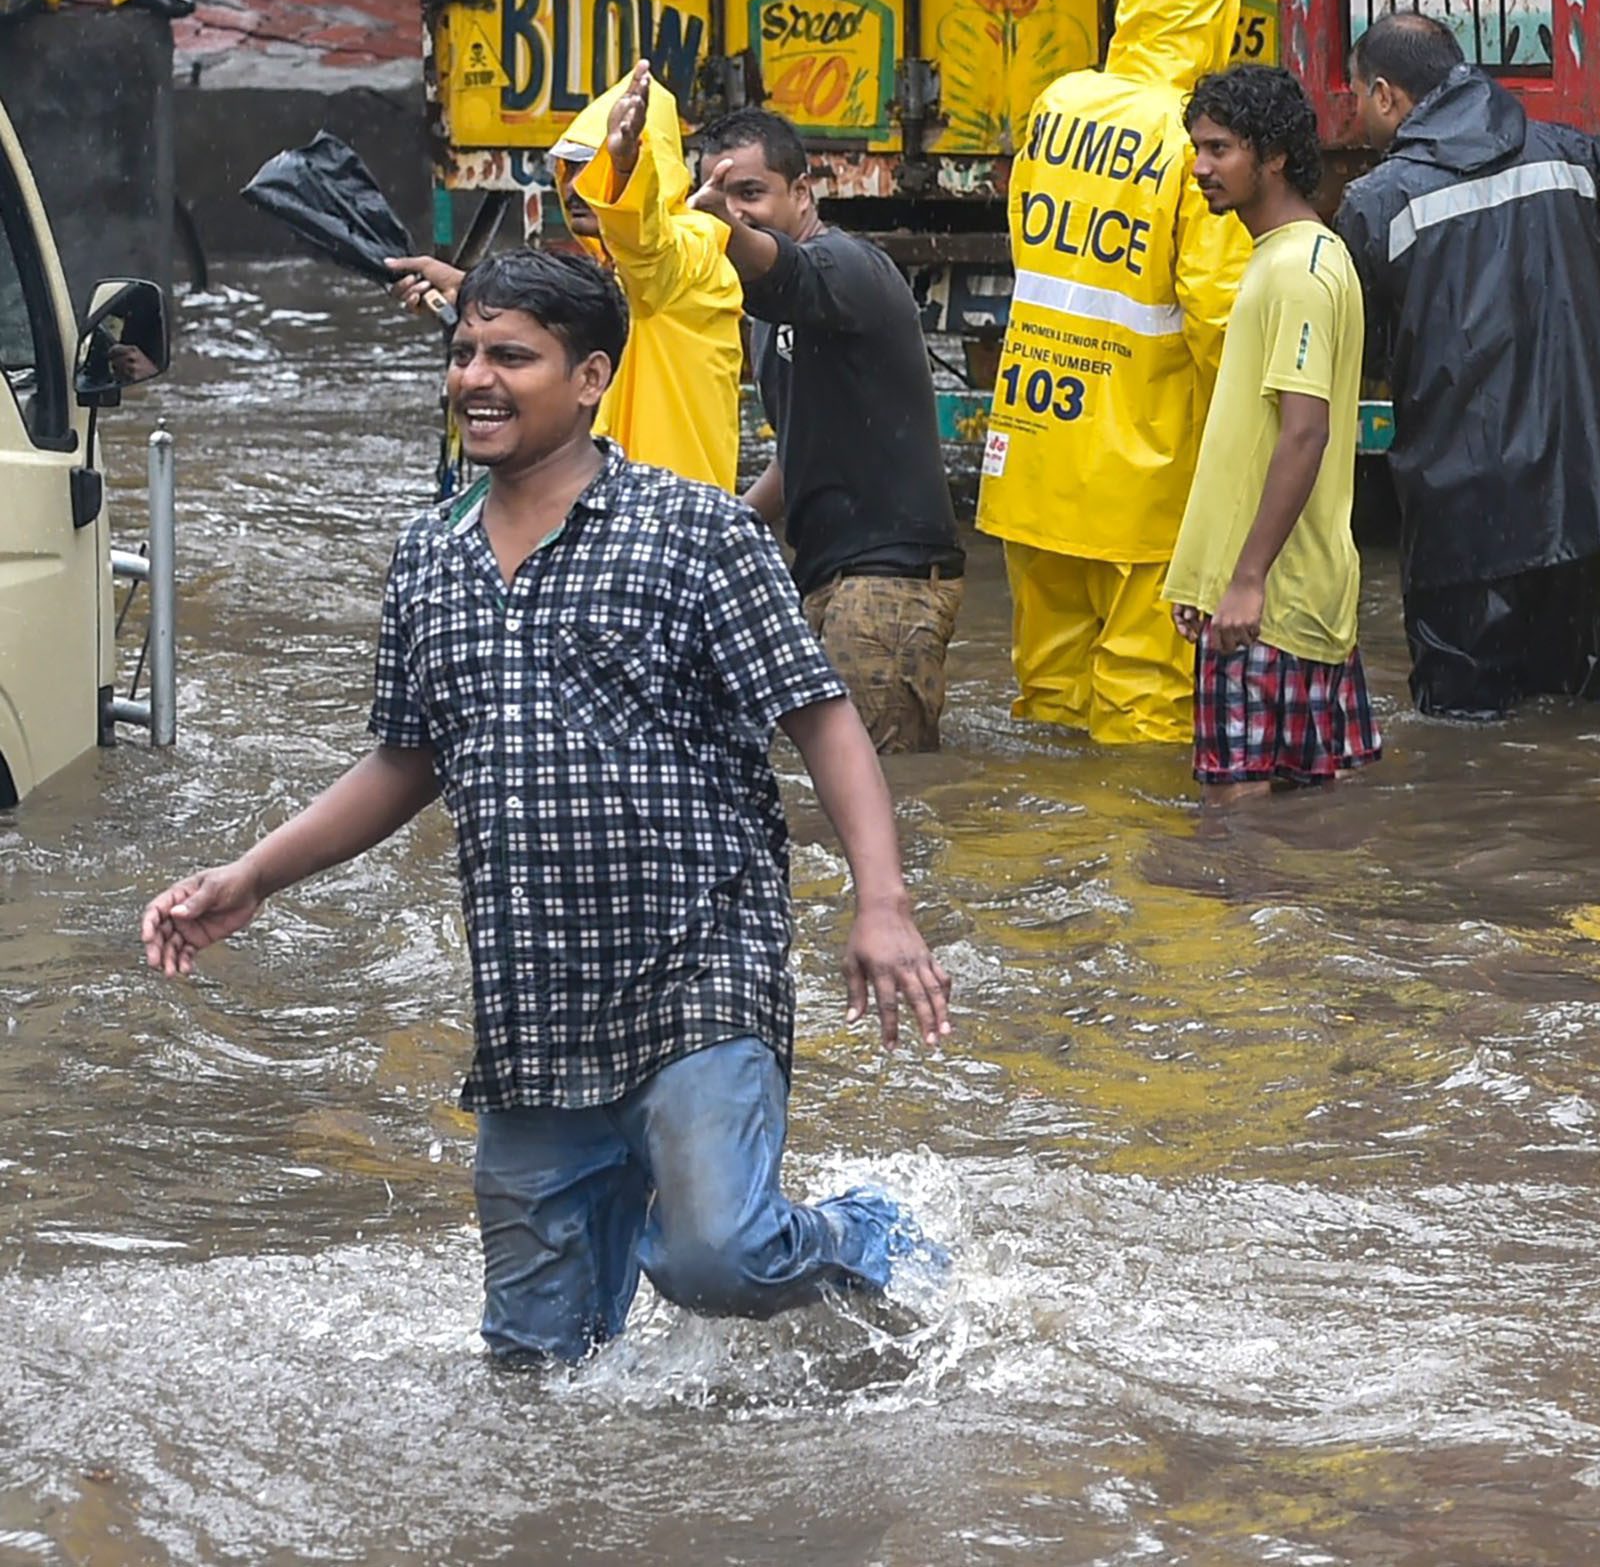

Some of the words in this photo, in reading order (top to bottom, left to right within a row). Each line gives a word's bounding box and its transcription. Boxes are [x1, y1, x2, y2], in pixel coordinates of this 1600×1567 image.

[762, 3, 868, 48] Speed
[464, 70, 495, 87] STOP
[772, 55, 850, 117] 40
[1002, 363, 1086, 422] 103
